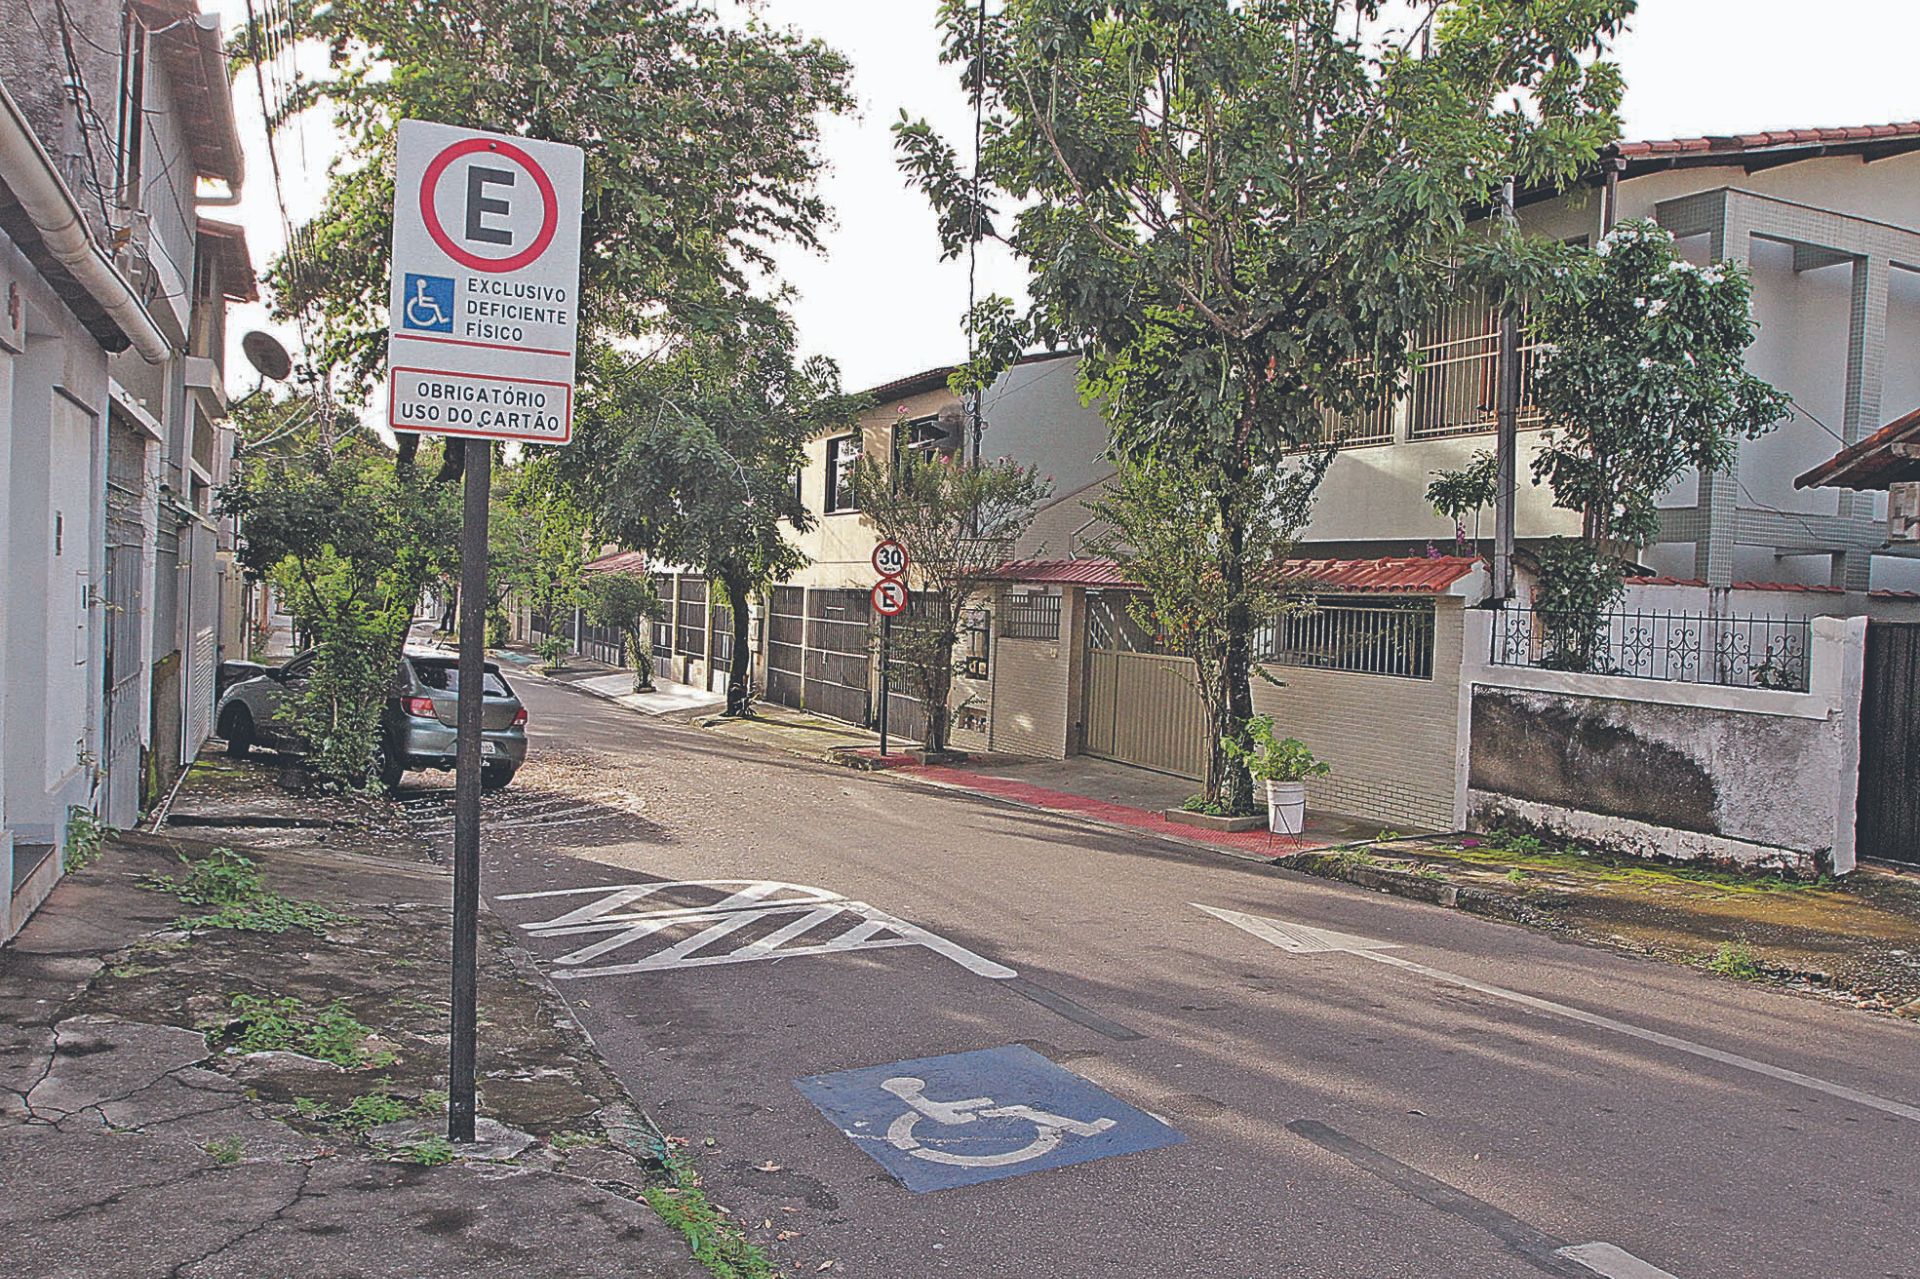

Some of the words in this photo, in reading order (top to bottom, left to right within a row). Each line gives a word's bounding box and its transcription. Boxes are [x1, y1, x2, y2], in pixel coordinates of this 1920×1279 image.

[465, 165, 515, 246] E
[468, 278, 566, 303] EXCLUSIVO
[467, 300, 567, 325] DEFICIENTE
[466, 319, 523, 341] FÍSICO
[417, 382, 546, 408] OBRIGATÓRIO
[401, 403, 440, 420] USO
[447, 407, 472, 424] DO
[481, 410, 559, 431] CARTÃO
[879, 549, 901, 566] 30
[883, 586, 896, 607] E
